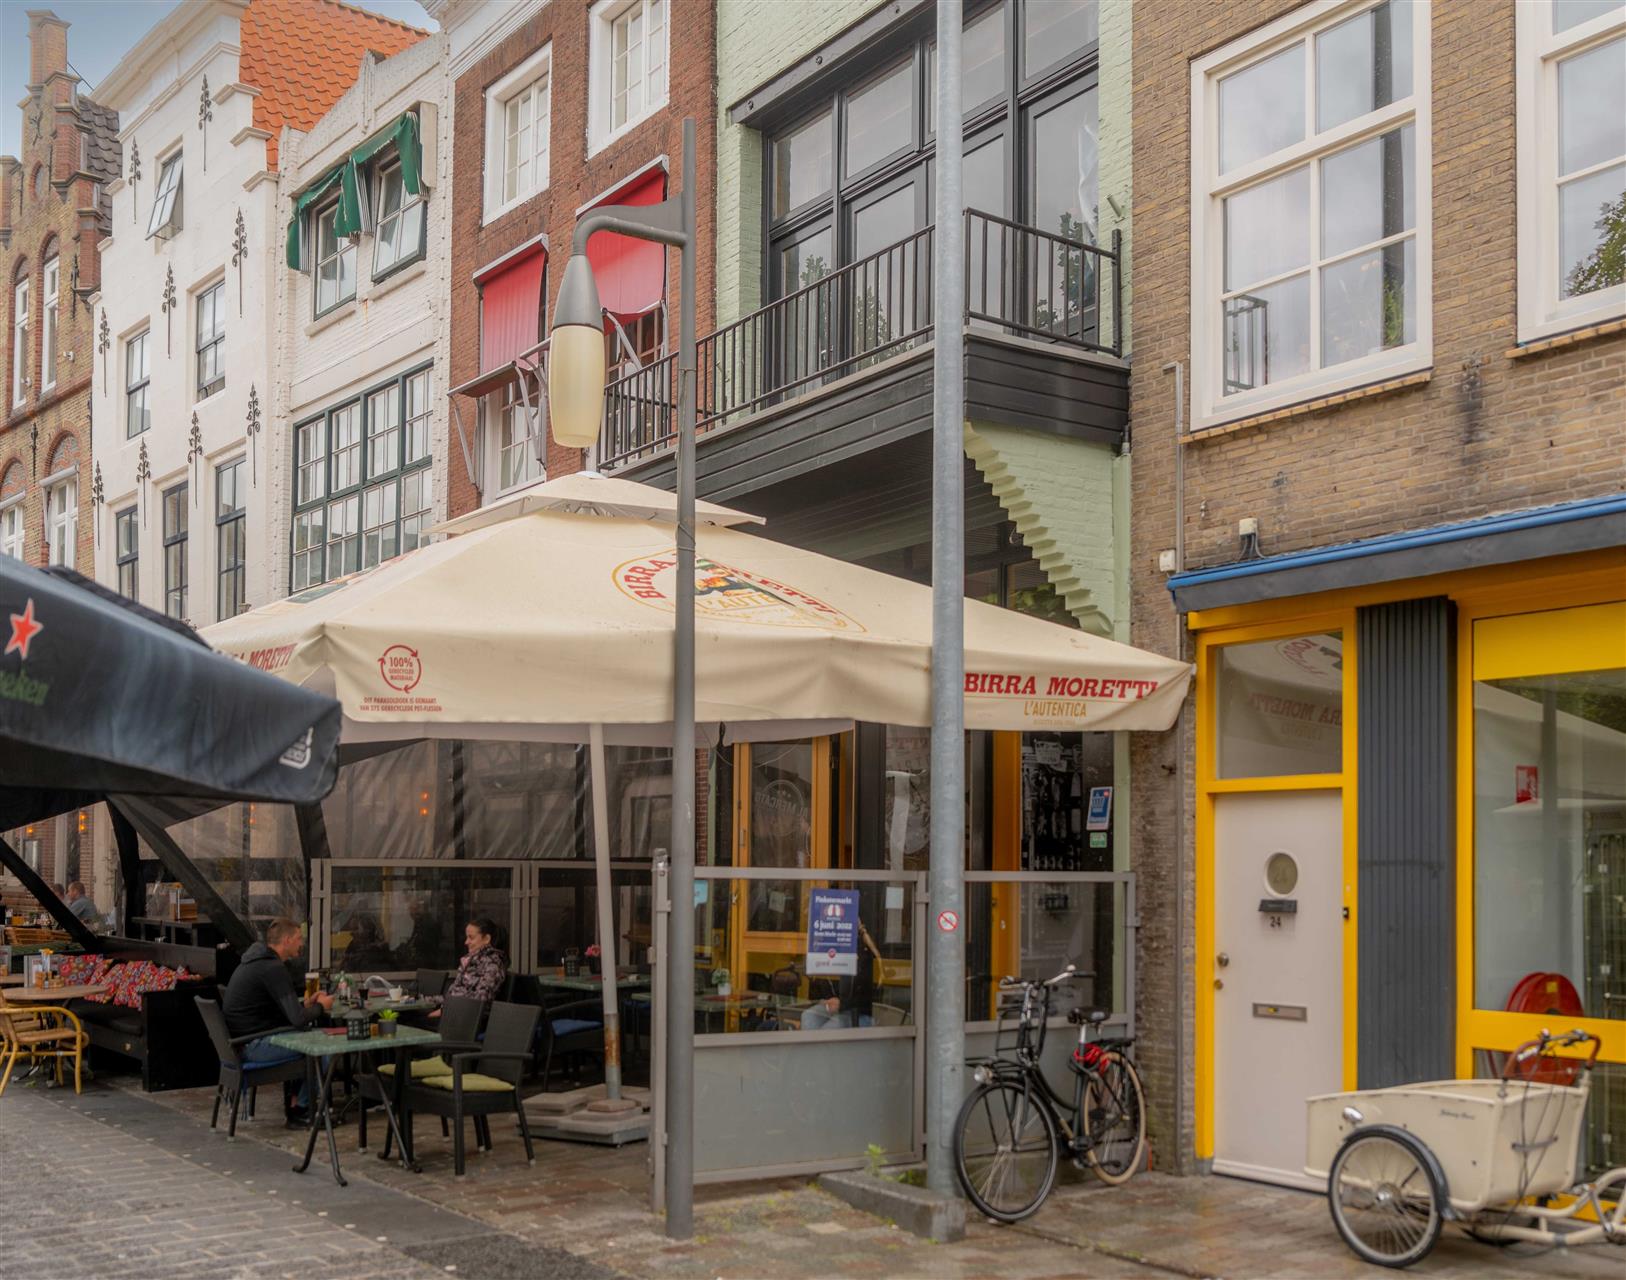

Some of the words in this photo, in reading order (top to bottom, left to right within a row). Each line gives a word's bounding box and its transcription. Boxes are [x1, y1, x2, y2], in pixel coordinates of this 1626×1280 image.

[624, 558, 676, 599] BIRRA
[389, 656, 414, 668] 100%
[963, 673, 1036, 695] BIRRA
[1046, 676, 1160, 700] MORETTI
[1023, 700, 1087, 718] L'AUTENTICA
[1270, 916, 1281, 928] 24
